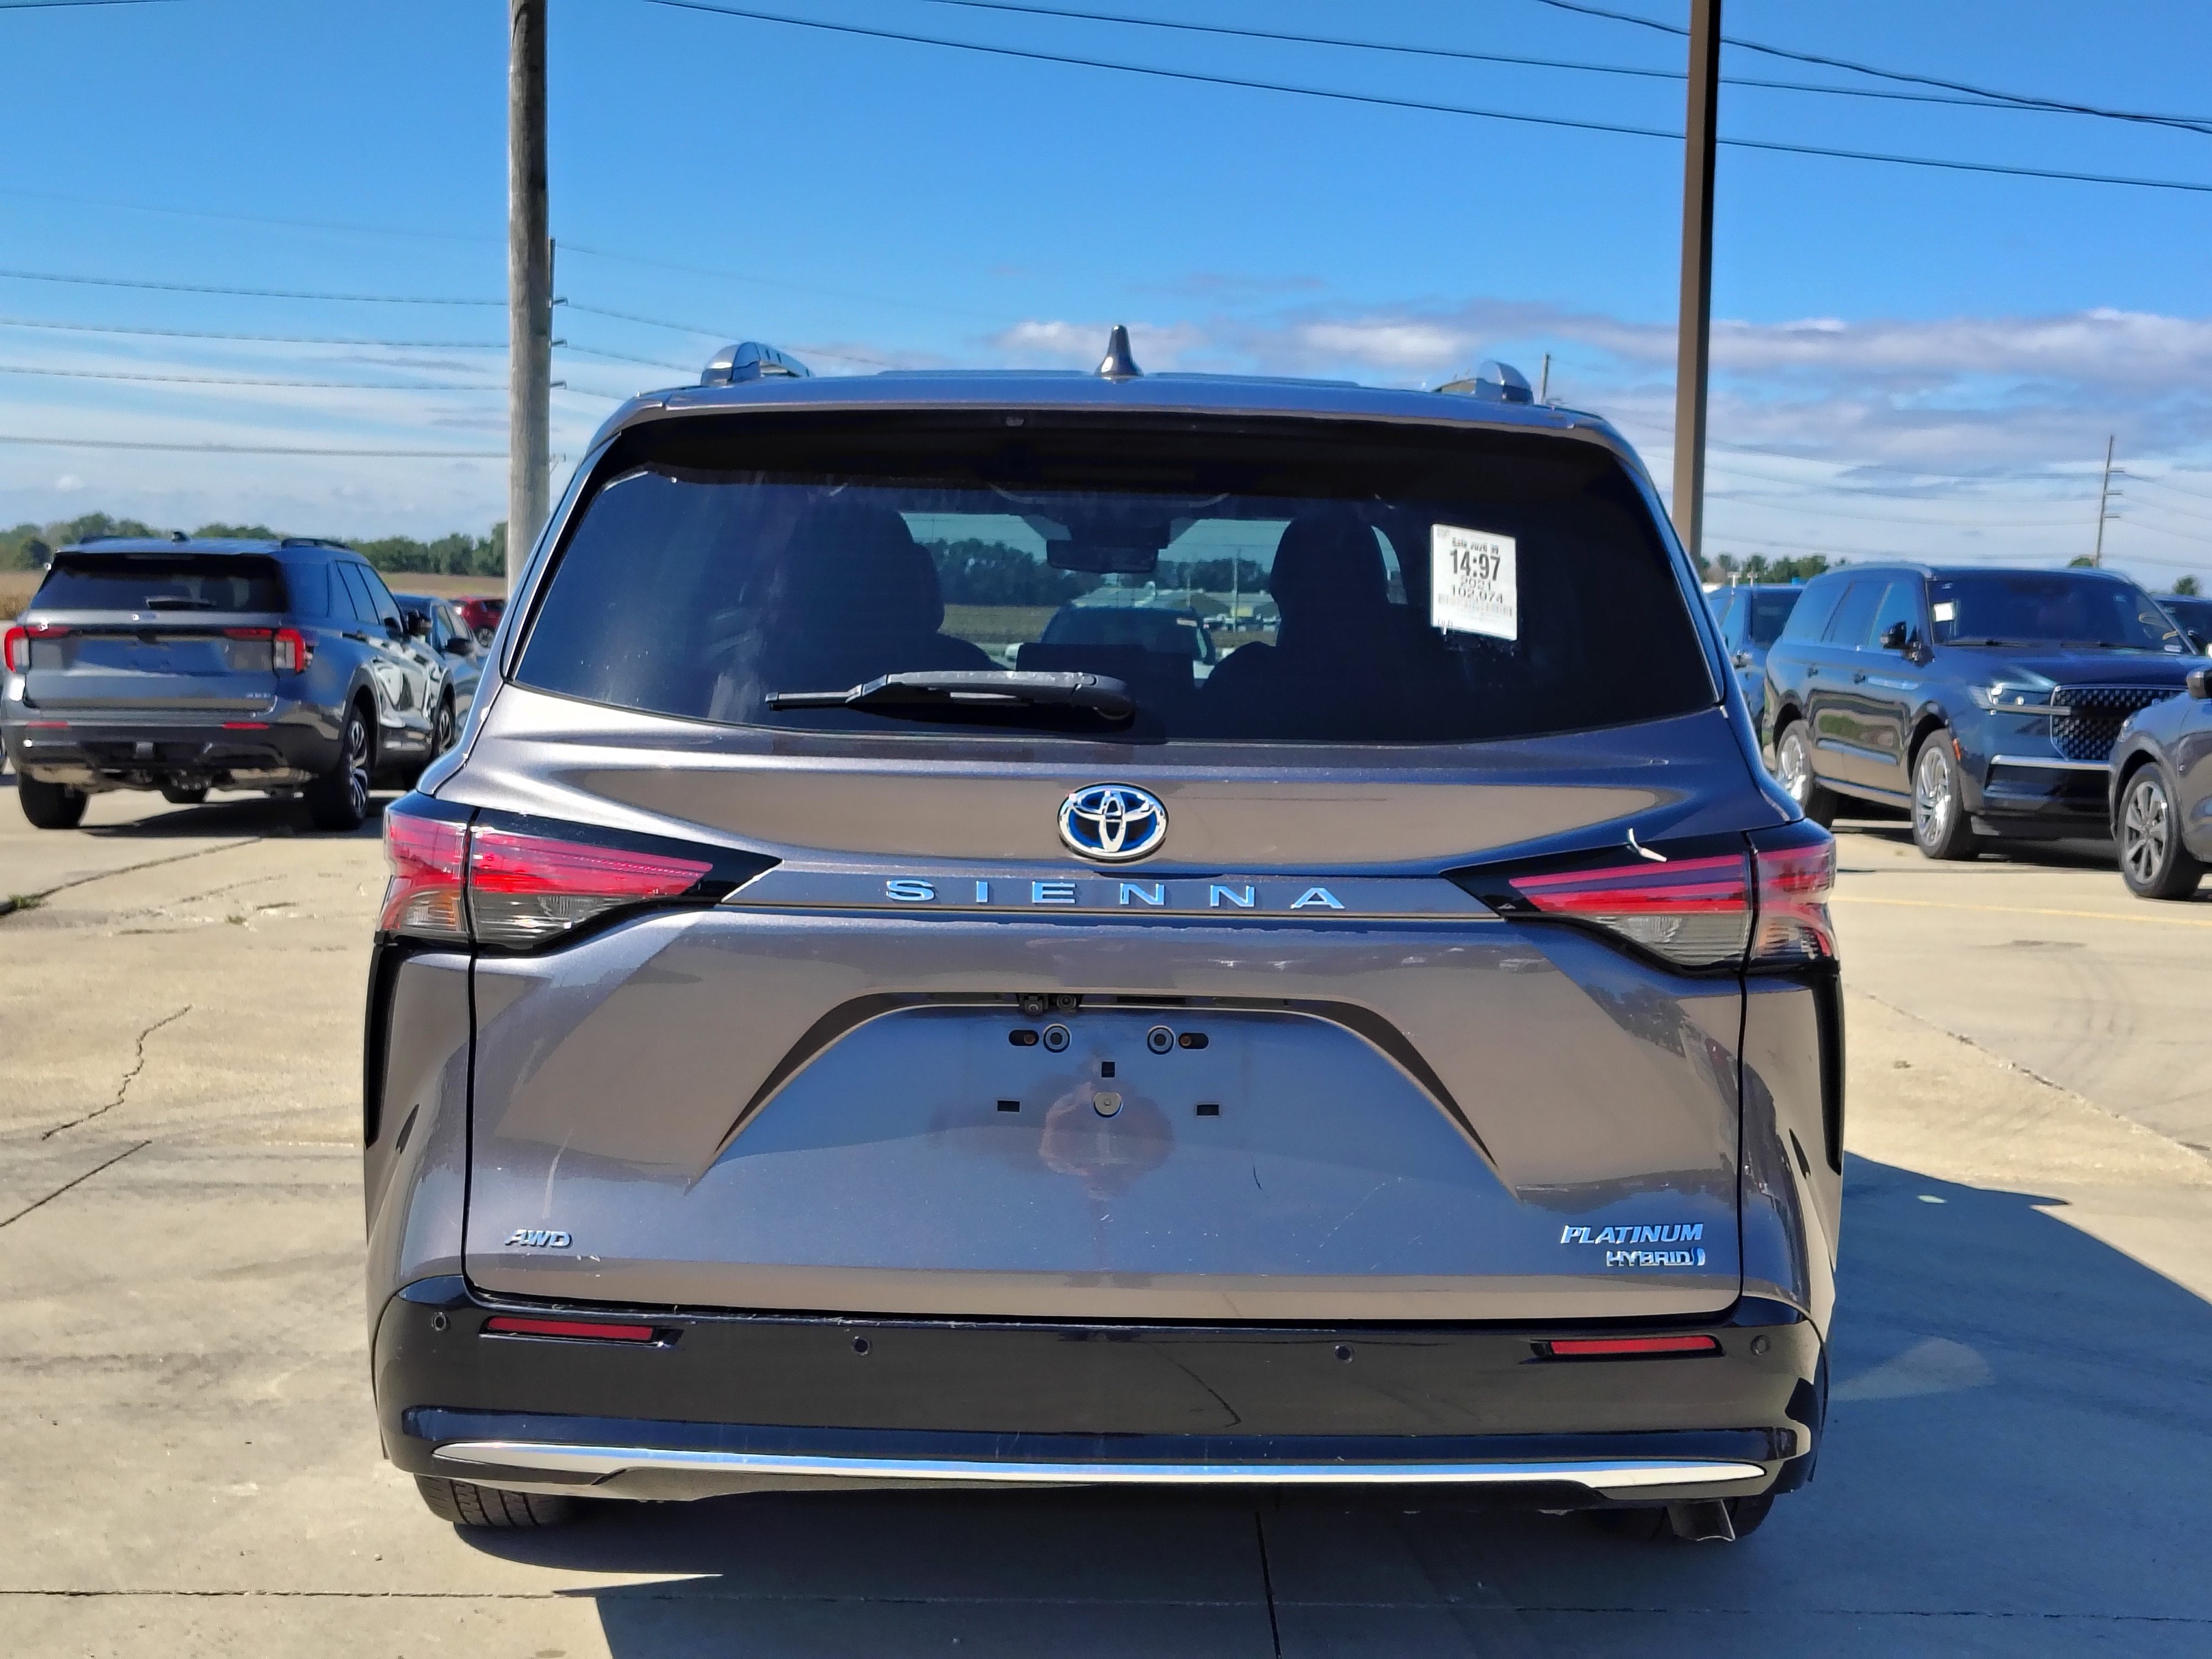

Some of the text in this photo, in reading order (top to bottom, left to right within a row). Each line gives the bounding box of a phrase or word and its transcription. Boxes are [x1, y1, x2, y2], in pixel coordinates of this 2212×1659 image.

[1450, 549, 1501, 581] 14:97
[1460, 575, 1491, 591] 2021
[886, 879, 1345, 909] SIENNA
[504, 1229, 571, 1247] AWD
[1560, 1223, 1703, 1244] PLATINUM
[1607, 1250, 1692, 1267] HYBRID
